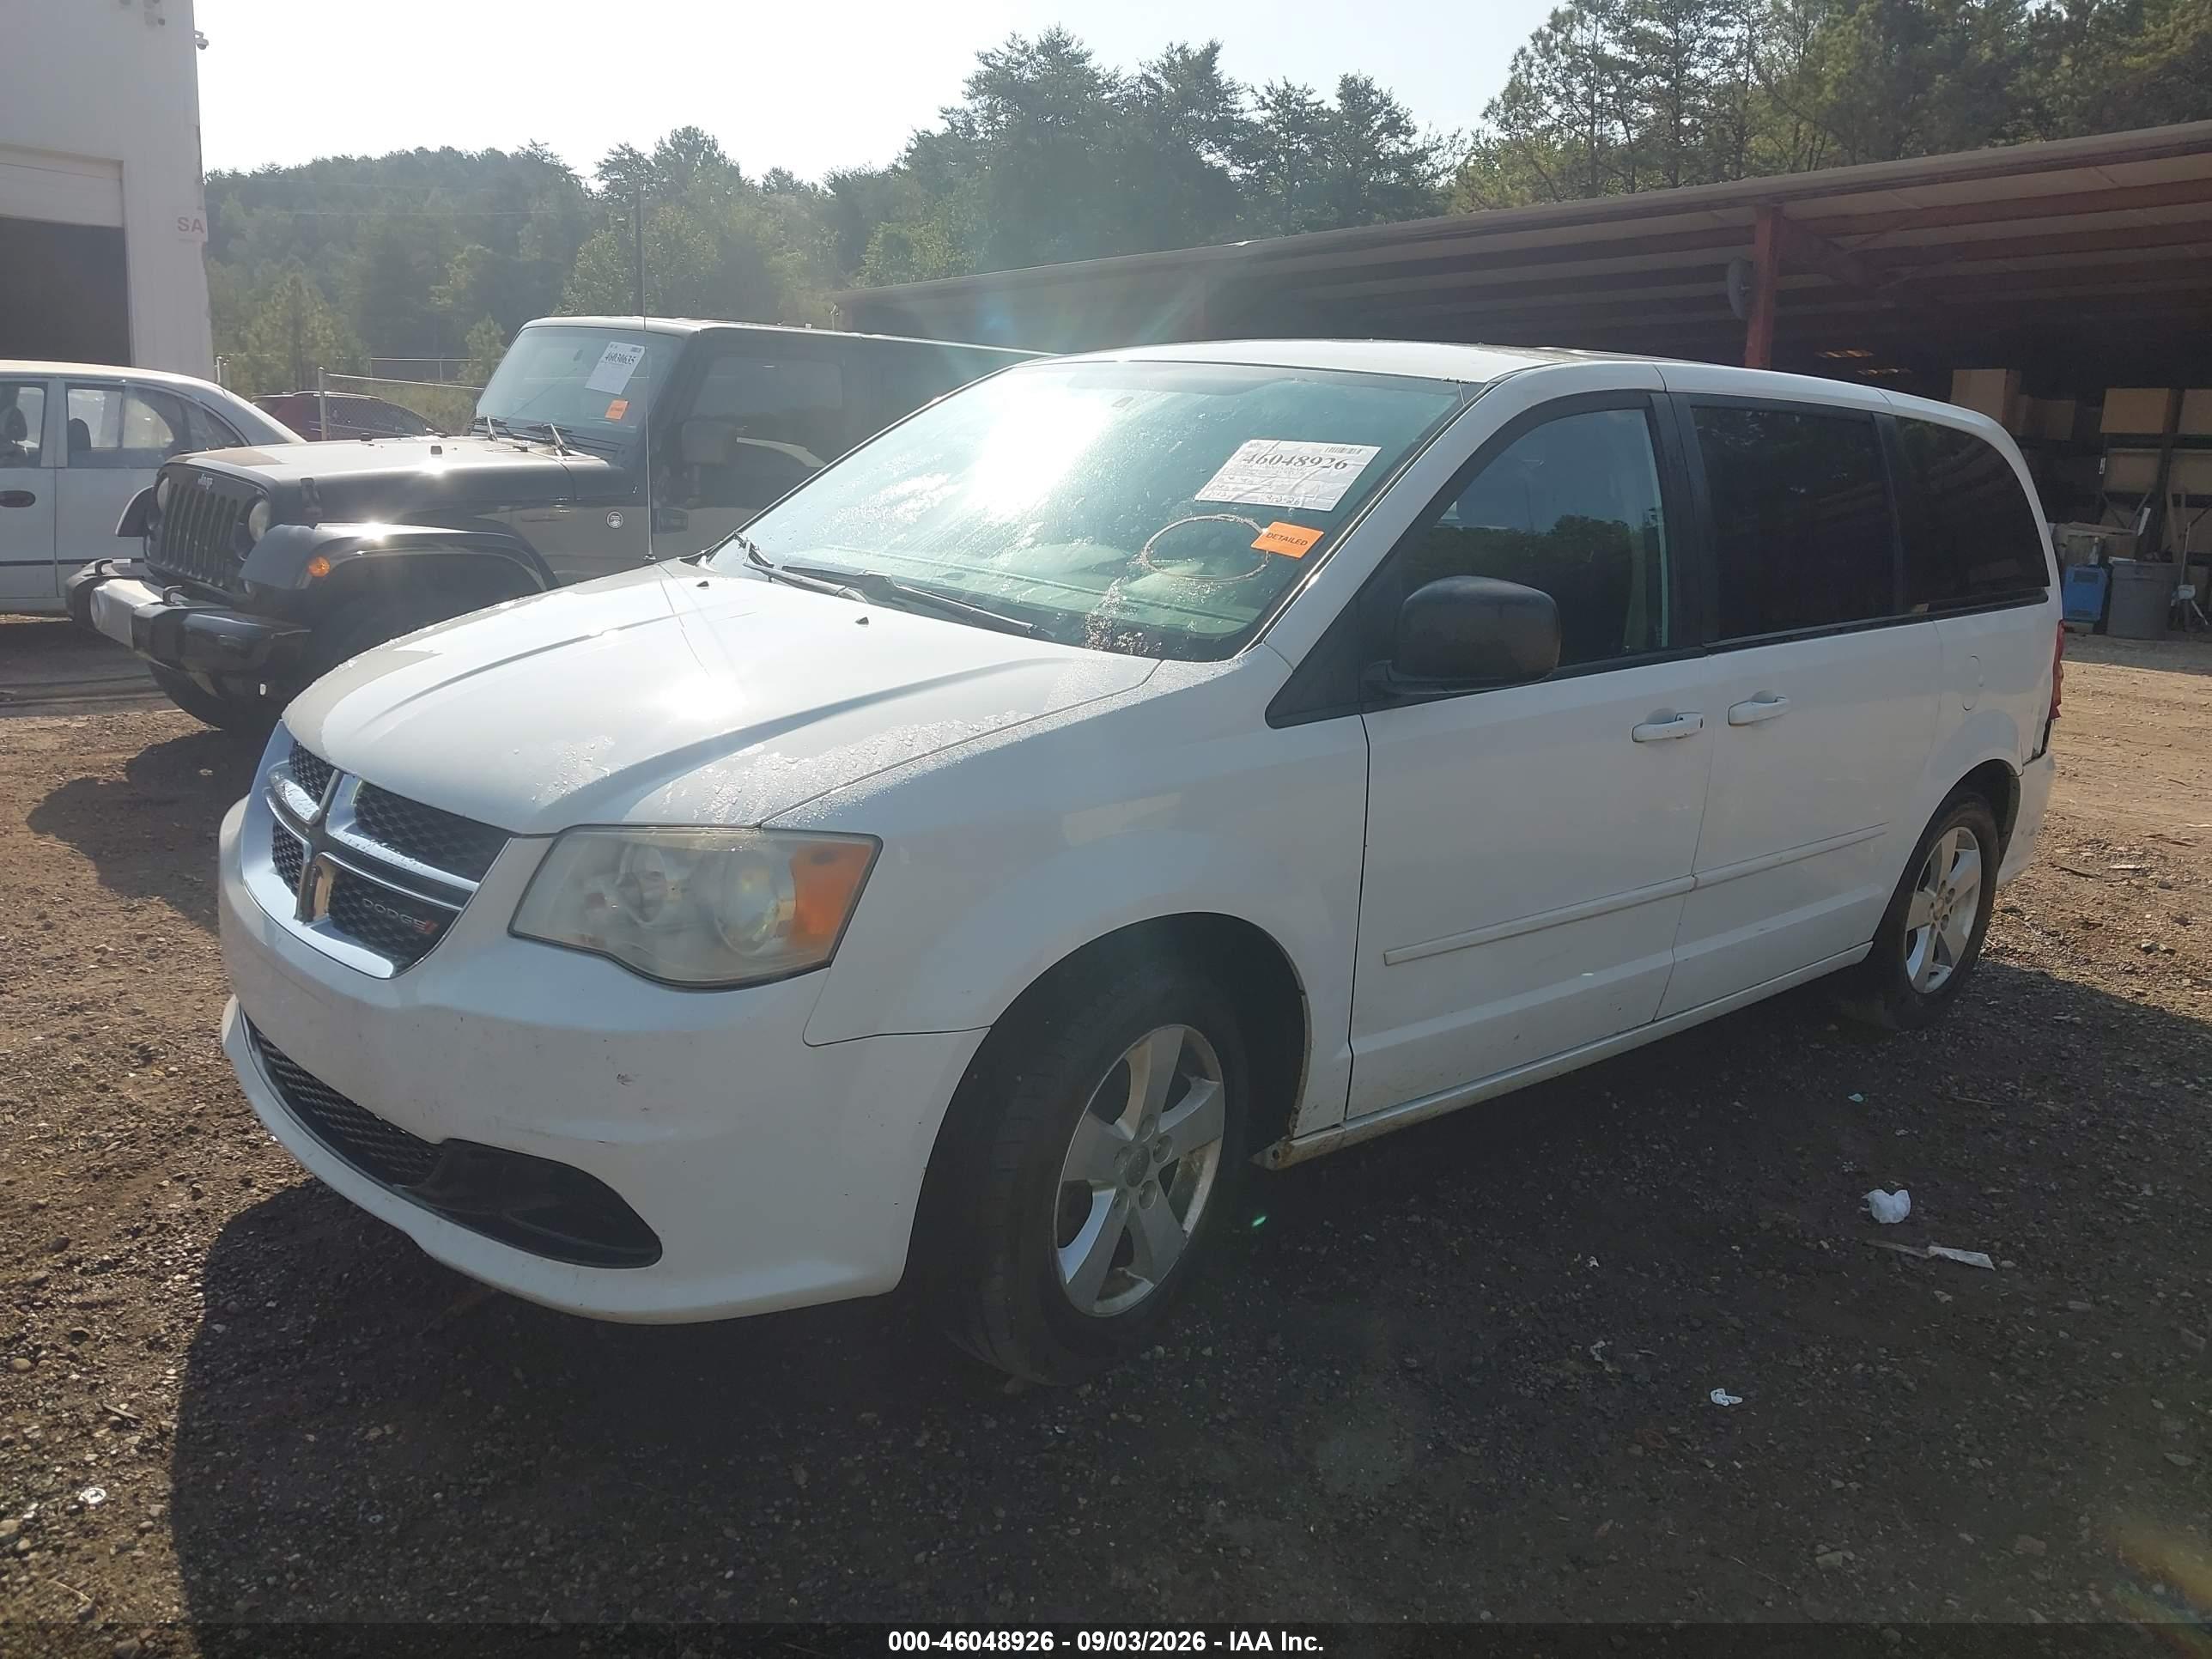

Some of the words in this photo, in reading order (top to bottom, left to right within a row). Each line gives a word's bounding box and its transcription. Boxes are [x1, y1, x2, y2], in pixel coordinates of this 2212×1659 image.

[178, 216, 204, 234] SA
[1243, 452, 1348, 471] 46048926
[198, 473, 214, 490] Jeep
[1266, 532, 1308, 547] DETAILED
[362, 897, 428, 935] DODGE
